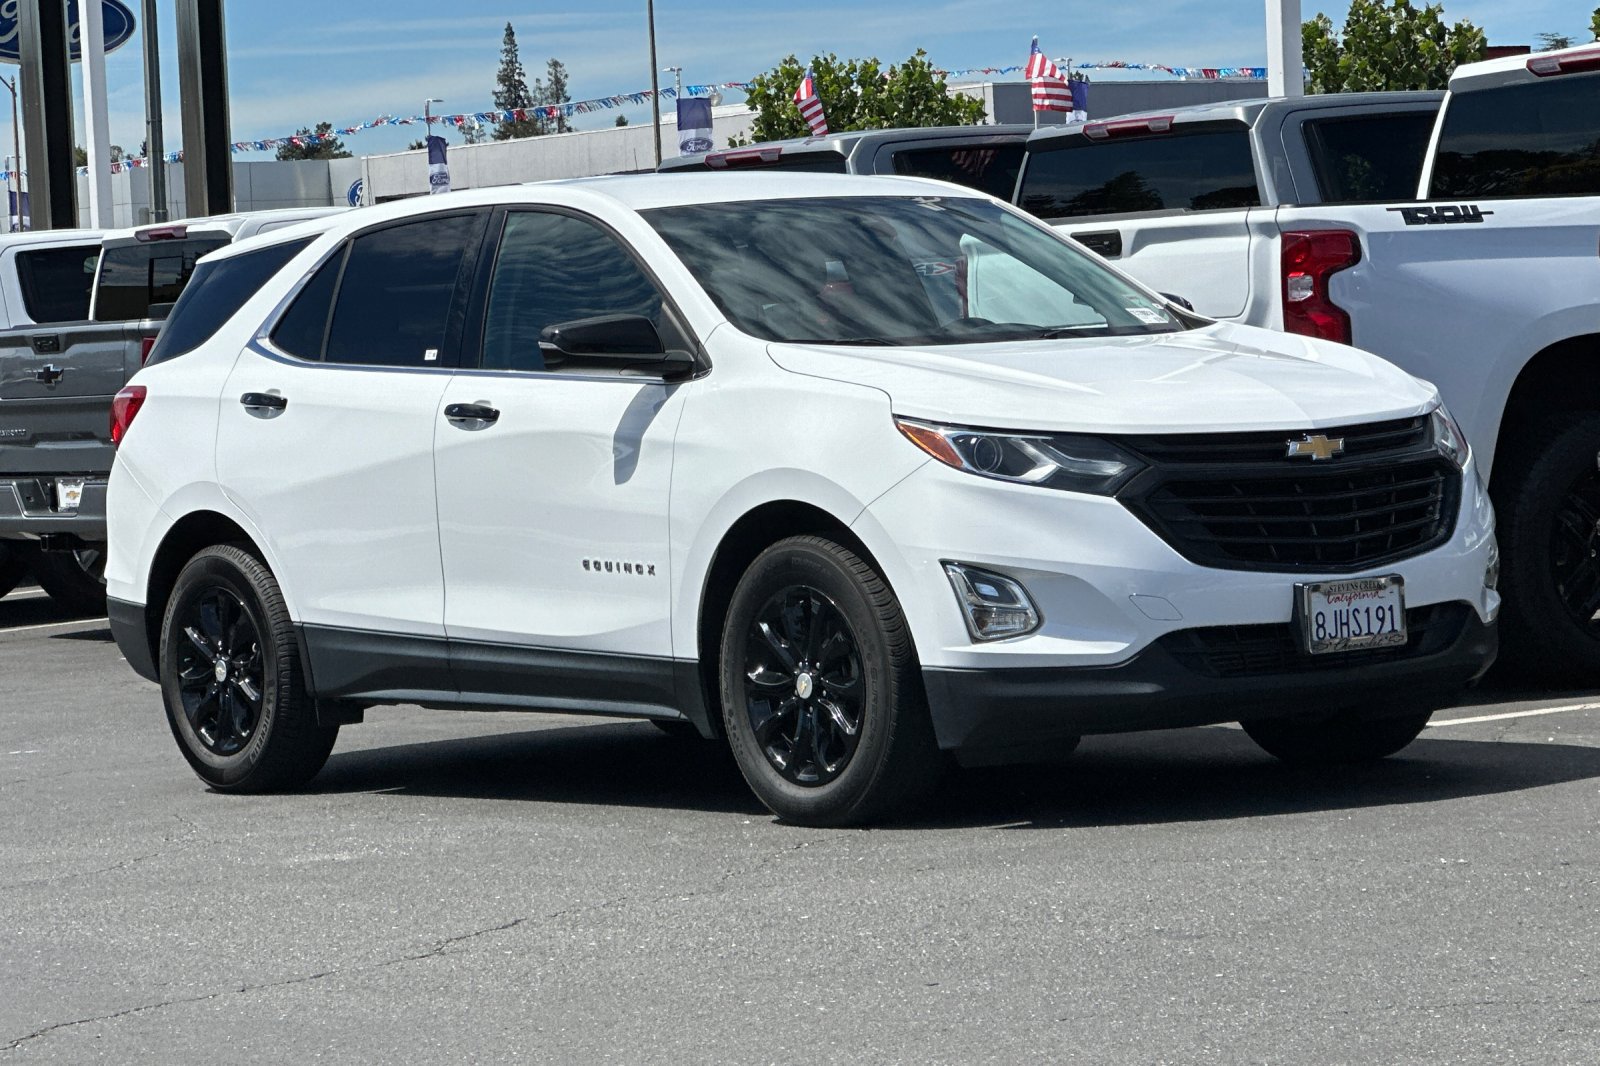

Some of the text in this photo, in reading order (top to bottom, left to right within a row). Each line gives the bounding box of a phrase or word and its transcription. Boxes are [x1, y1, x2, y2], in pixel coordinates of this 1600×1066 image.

[582, 559, 656, 576] EQUINOX
[1328, 582, 1358, 592] STEVENS
[1327, 590, 1386, 606] California
[1315, 604, 1399, 640] 8JHS191
[251, 707, 271, 759] MICHELIN
